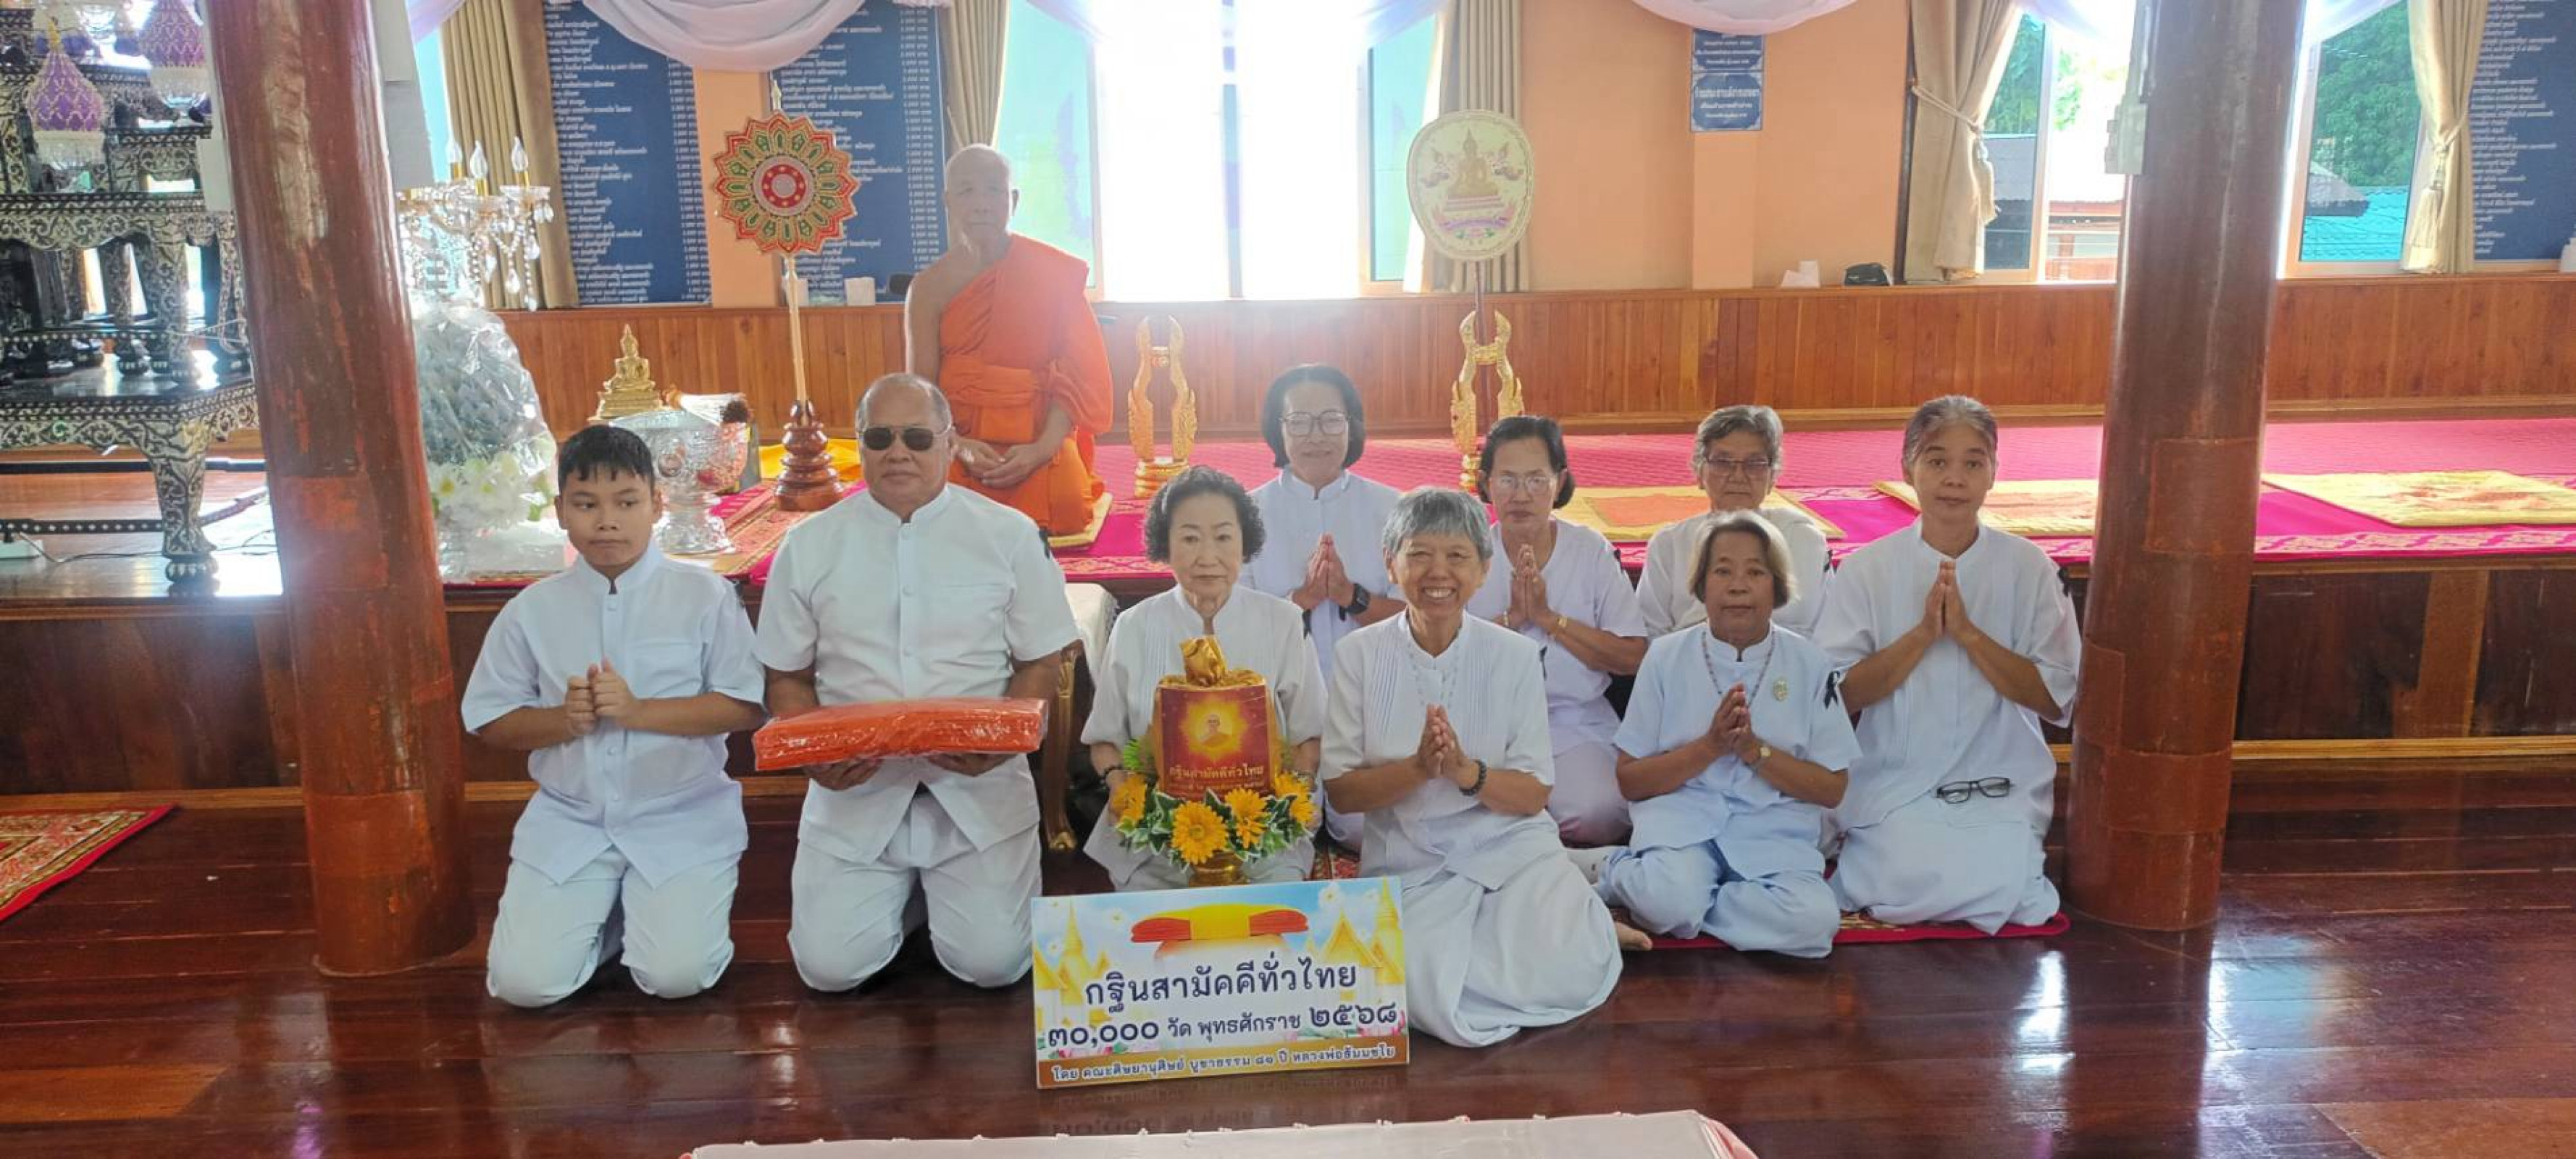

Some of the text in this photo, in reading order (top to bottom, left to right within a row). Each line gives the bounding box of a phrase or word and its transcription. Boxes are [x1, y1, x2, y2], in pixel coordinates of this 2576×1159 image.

[1085, 950, 1357, 1014] กฐินสามัคคีทั่วไทย
[1048, 1001, 1398, 1047] ๓๐,๐๐๐ วัด พุทธศักราช ๒๕๖๘
[1053, 1066, 1079, 1081] โดย
[1082, 1058, 1185, 1079] คณะศิษยานุศิษย์
[1189, 1056, 1251, 1074] บูชาธรรม
[1278, 1049, 1289, 1063] ปี
